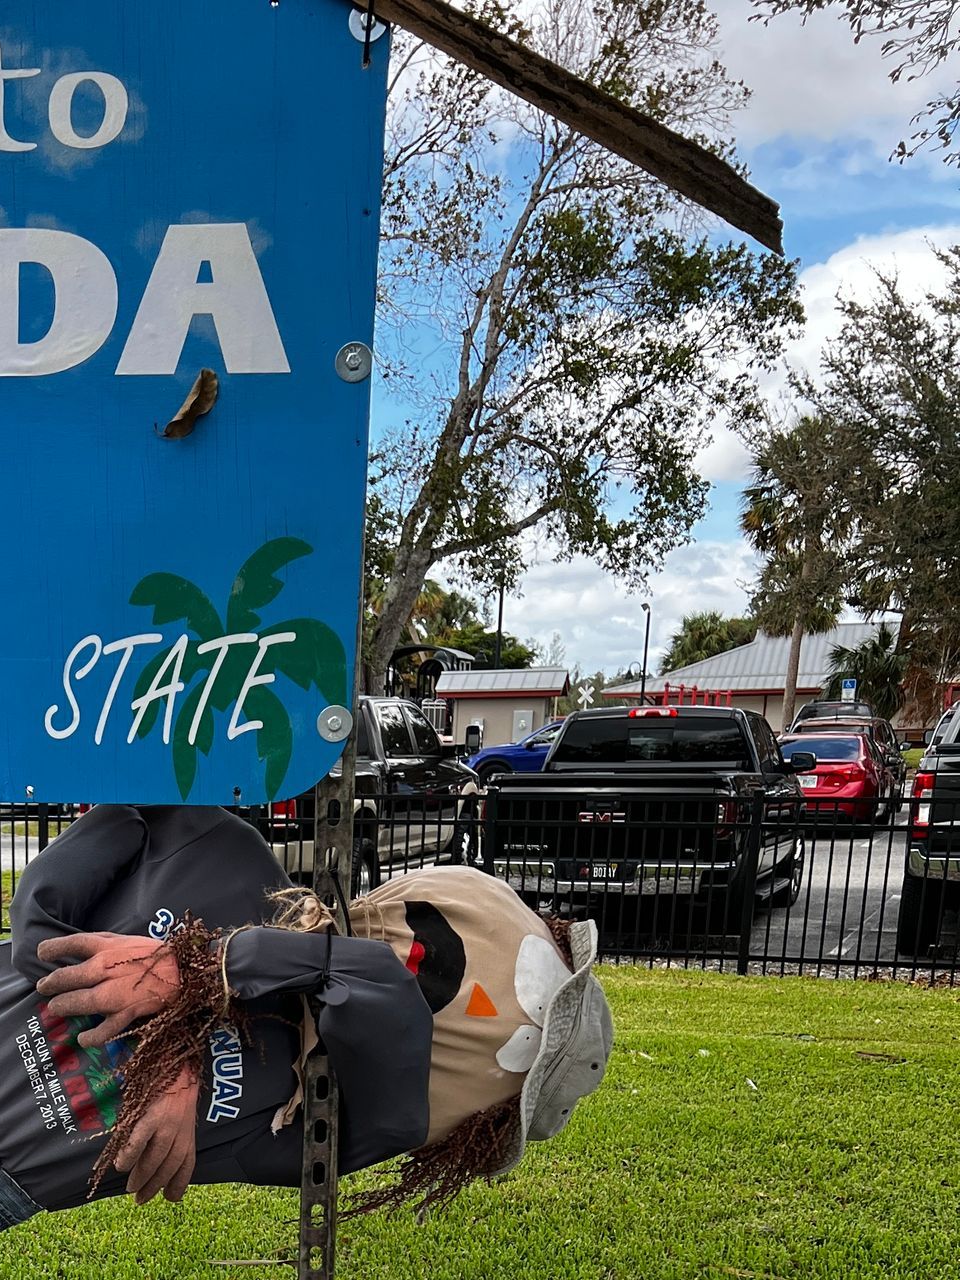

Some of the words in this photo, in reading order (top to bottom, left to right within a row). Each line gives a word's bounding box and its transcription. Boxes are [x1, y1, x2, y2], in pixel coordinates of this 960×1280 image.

[44, 632, 297, 746] STATE
[26, 1015, 43, 1038] 10K
[33, 1036, 52, 1063] RUN
[42, 1062, 54, 1071] &
[44, 1070, 57, 1080] 2
[206, 1026, 244, 1123] NUAL
[15, 1033, 45, 1097] DECEMBER
[39, 1103, 58, 1130] 2013
[47, 1079, 66, 1105] MILE
[56, 1103, 78, 1135] WALK
